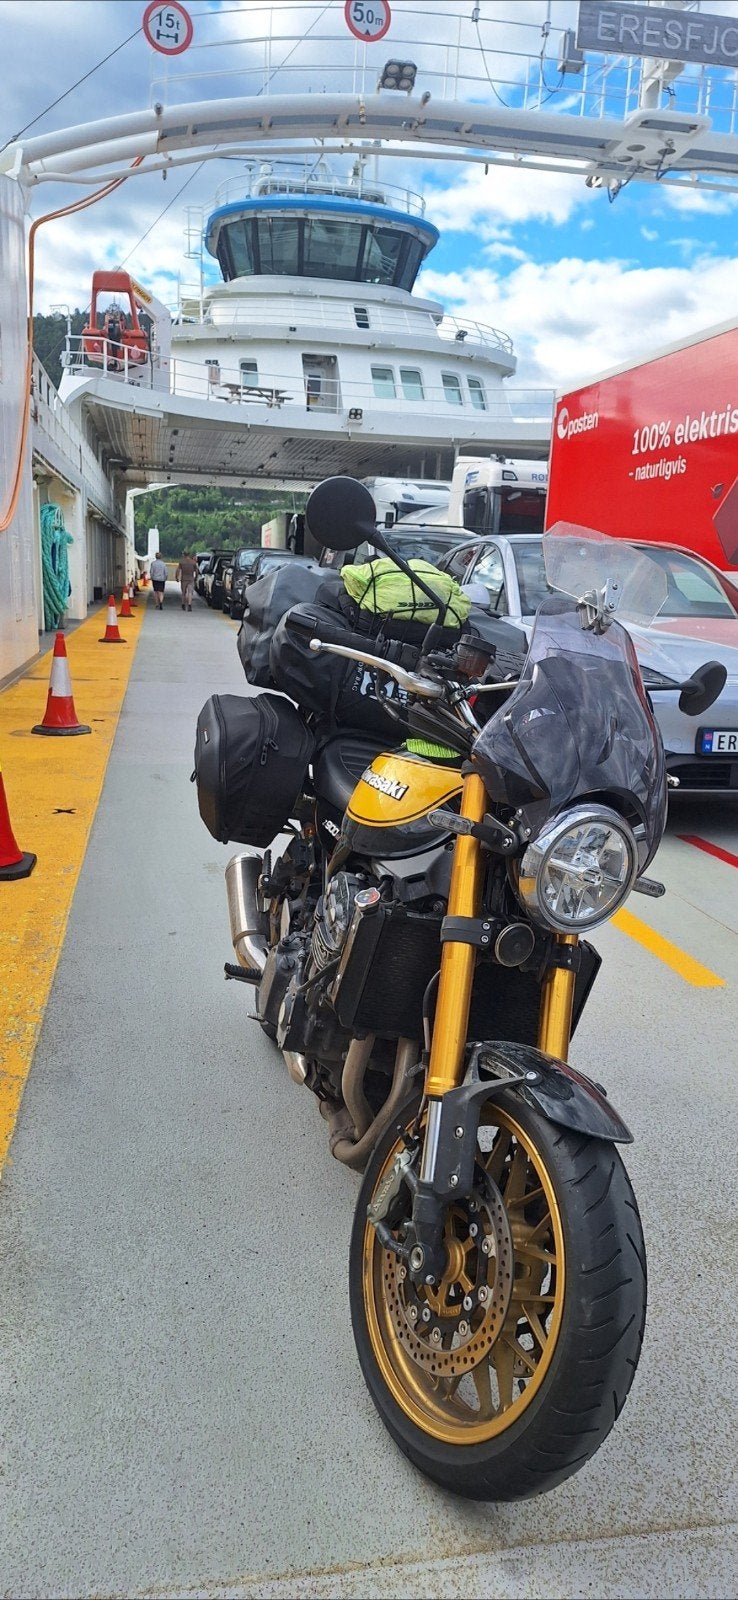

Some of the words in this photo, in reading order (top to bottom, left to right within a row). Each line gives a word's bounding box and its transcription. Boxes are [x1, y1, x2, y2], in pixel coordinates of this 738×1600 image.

[568, 412, 599, 440] posten
[632, 420, 672, 455] 100%
[674, 404, 738, 445] elektris
[635, 456, 687, 481] naturligvis
[717, 735, 738, 750] ER
